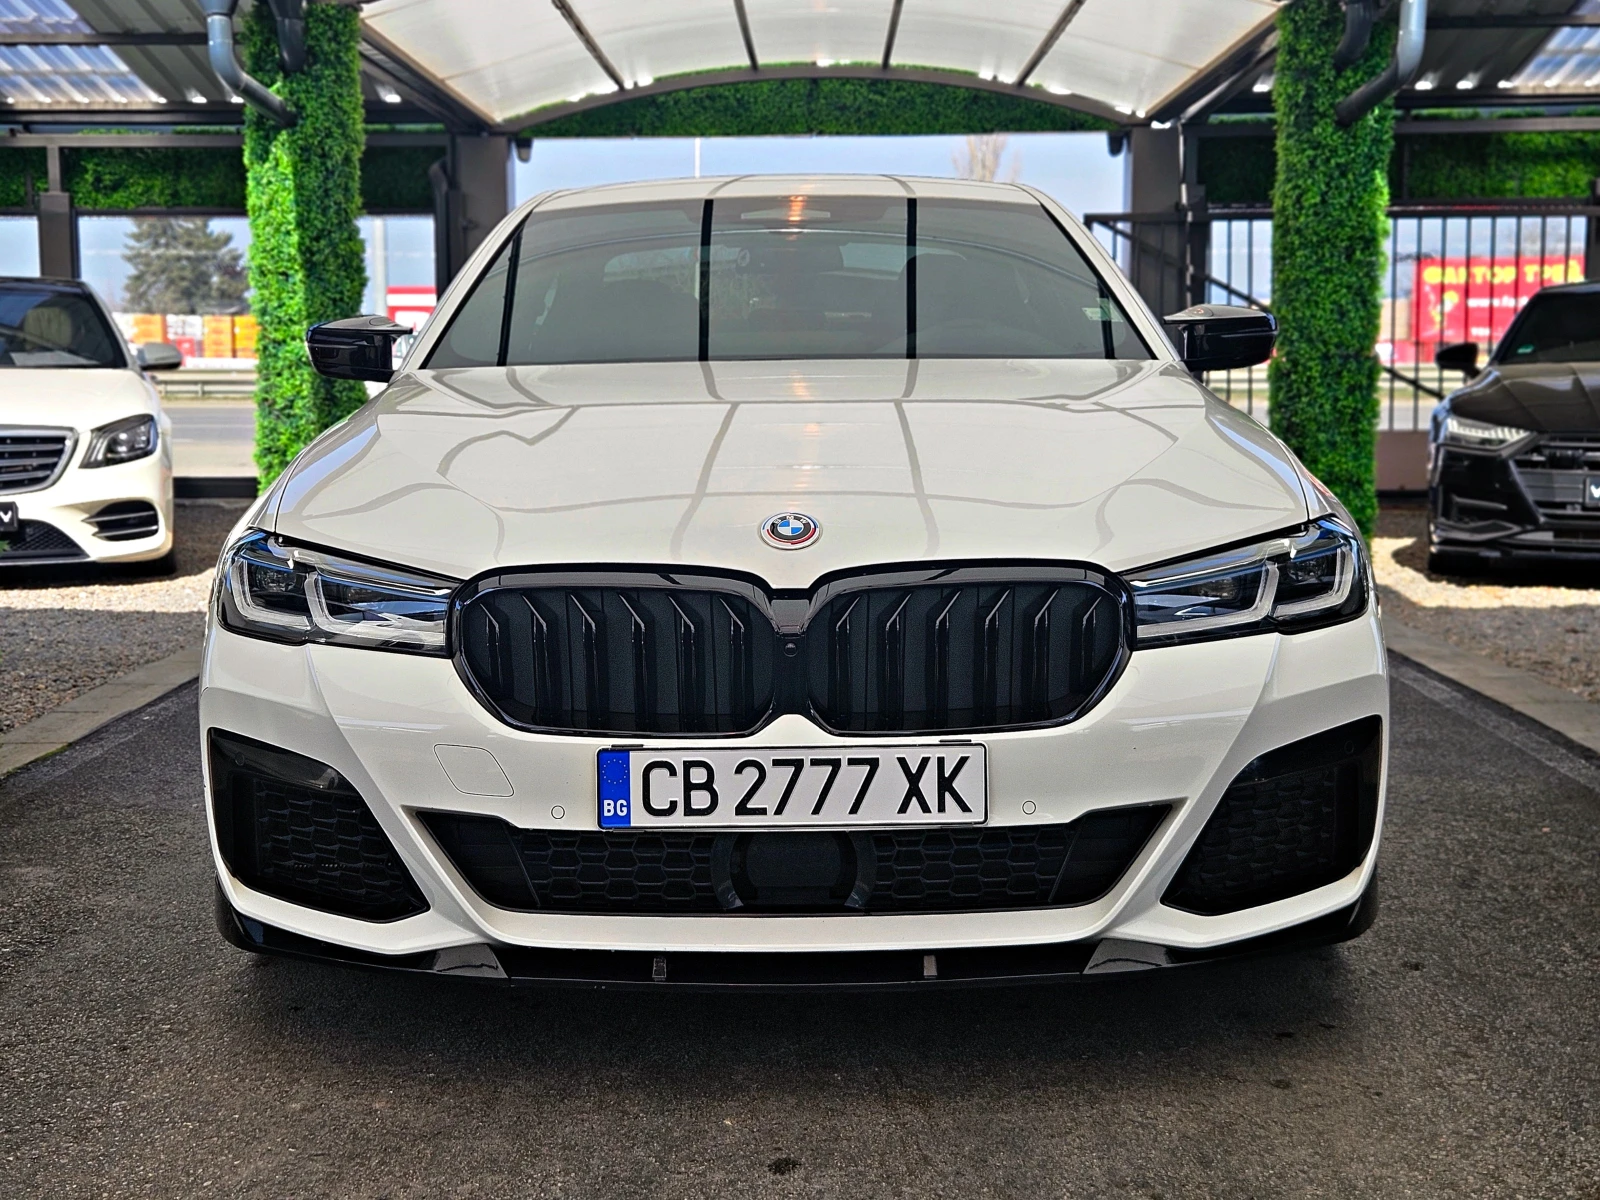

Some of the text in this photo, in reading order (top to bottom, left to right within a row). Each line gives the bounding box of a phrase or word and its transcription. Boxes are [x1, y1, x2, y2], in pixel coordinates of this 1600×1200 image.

[641, 755, 973, 817] CB 2777 XK
[603, 799, 628, 817] BG
